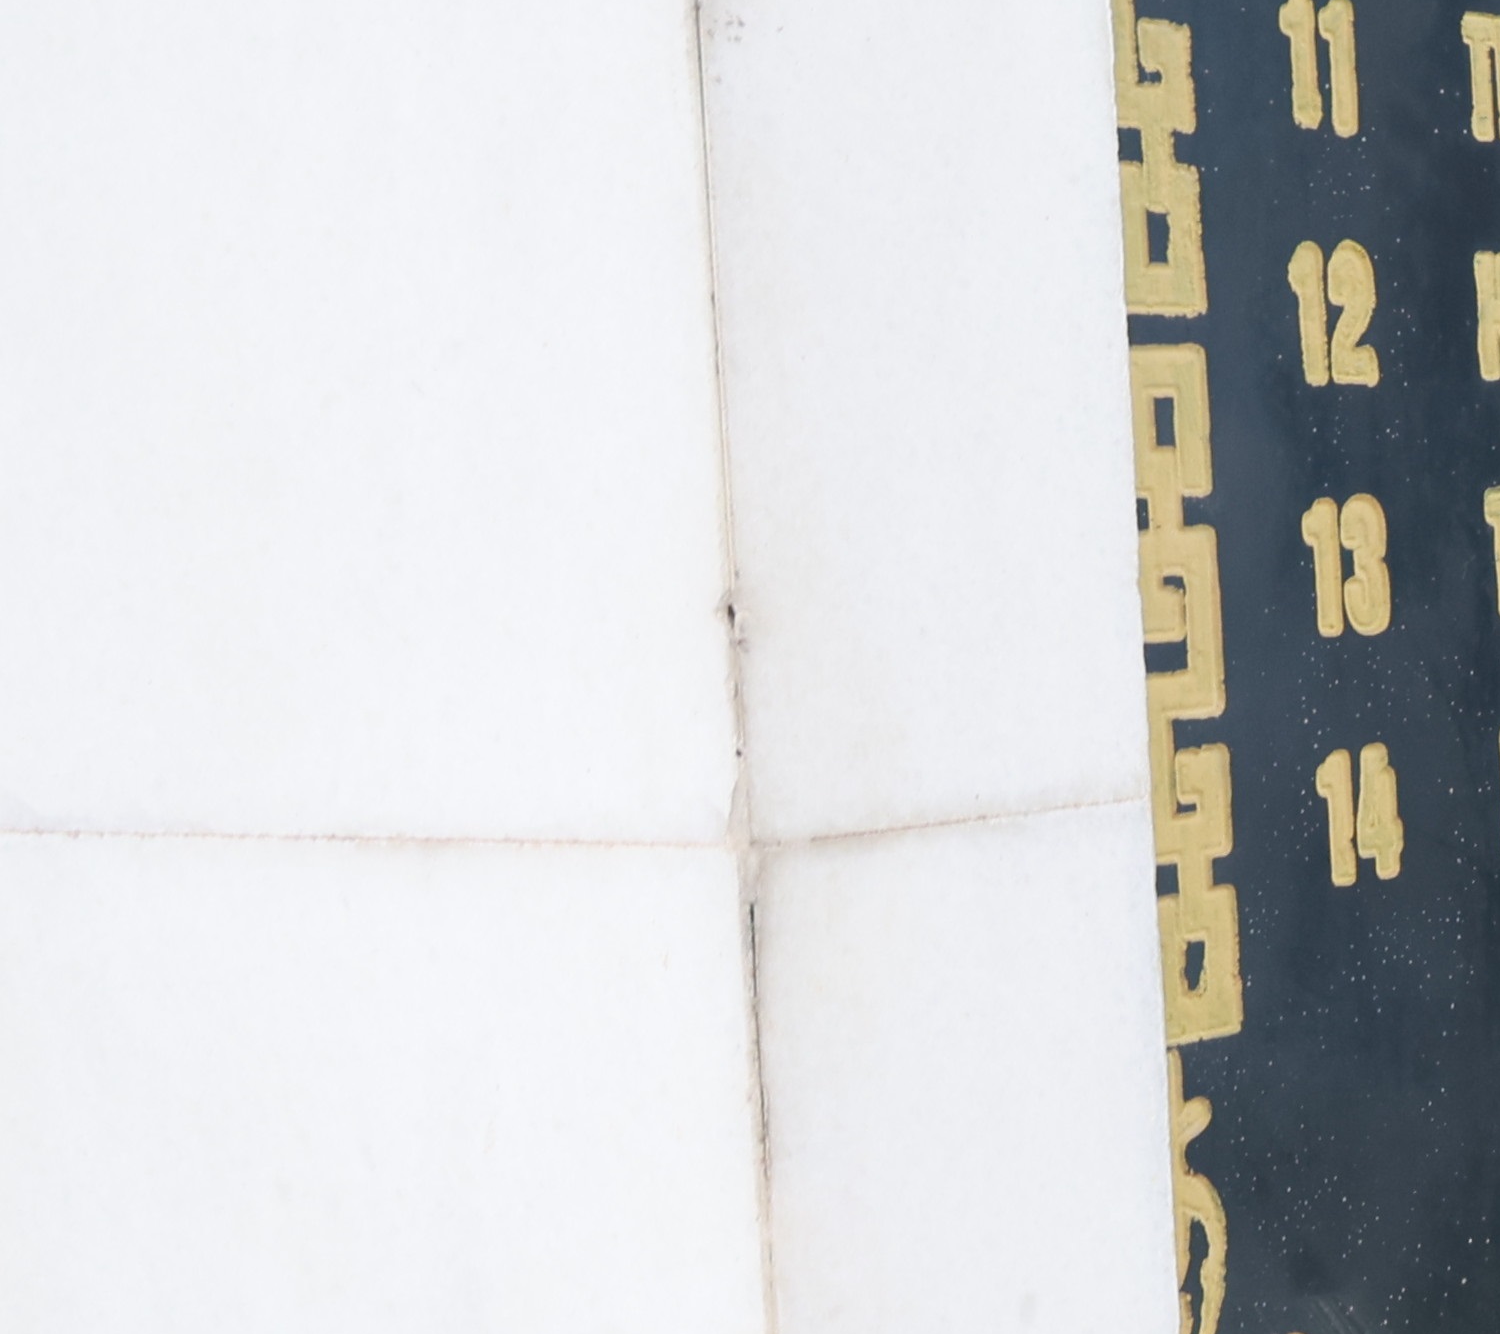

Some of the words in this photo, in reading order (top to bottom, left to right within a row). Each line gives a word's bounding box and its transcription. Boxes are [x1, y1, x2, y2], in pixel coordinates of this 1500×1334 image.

[1287, 238, 1380, 387] 12
[1301, 492, 1391, 637] 13
[1315, 742, 1404, 887] 14
